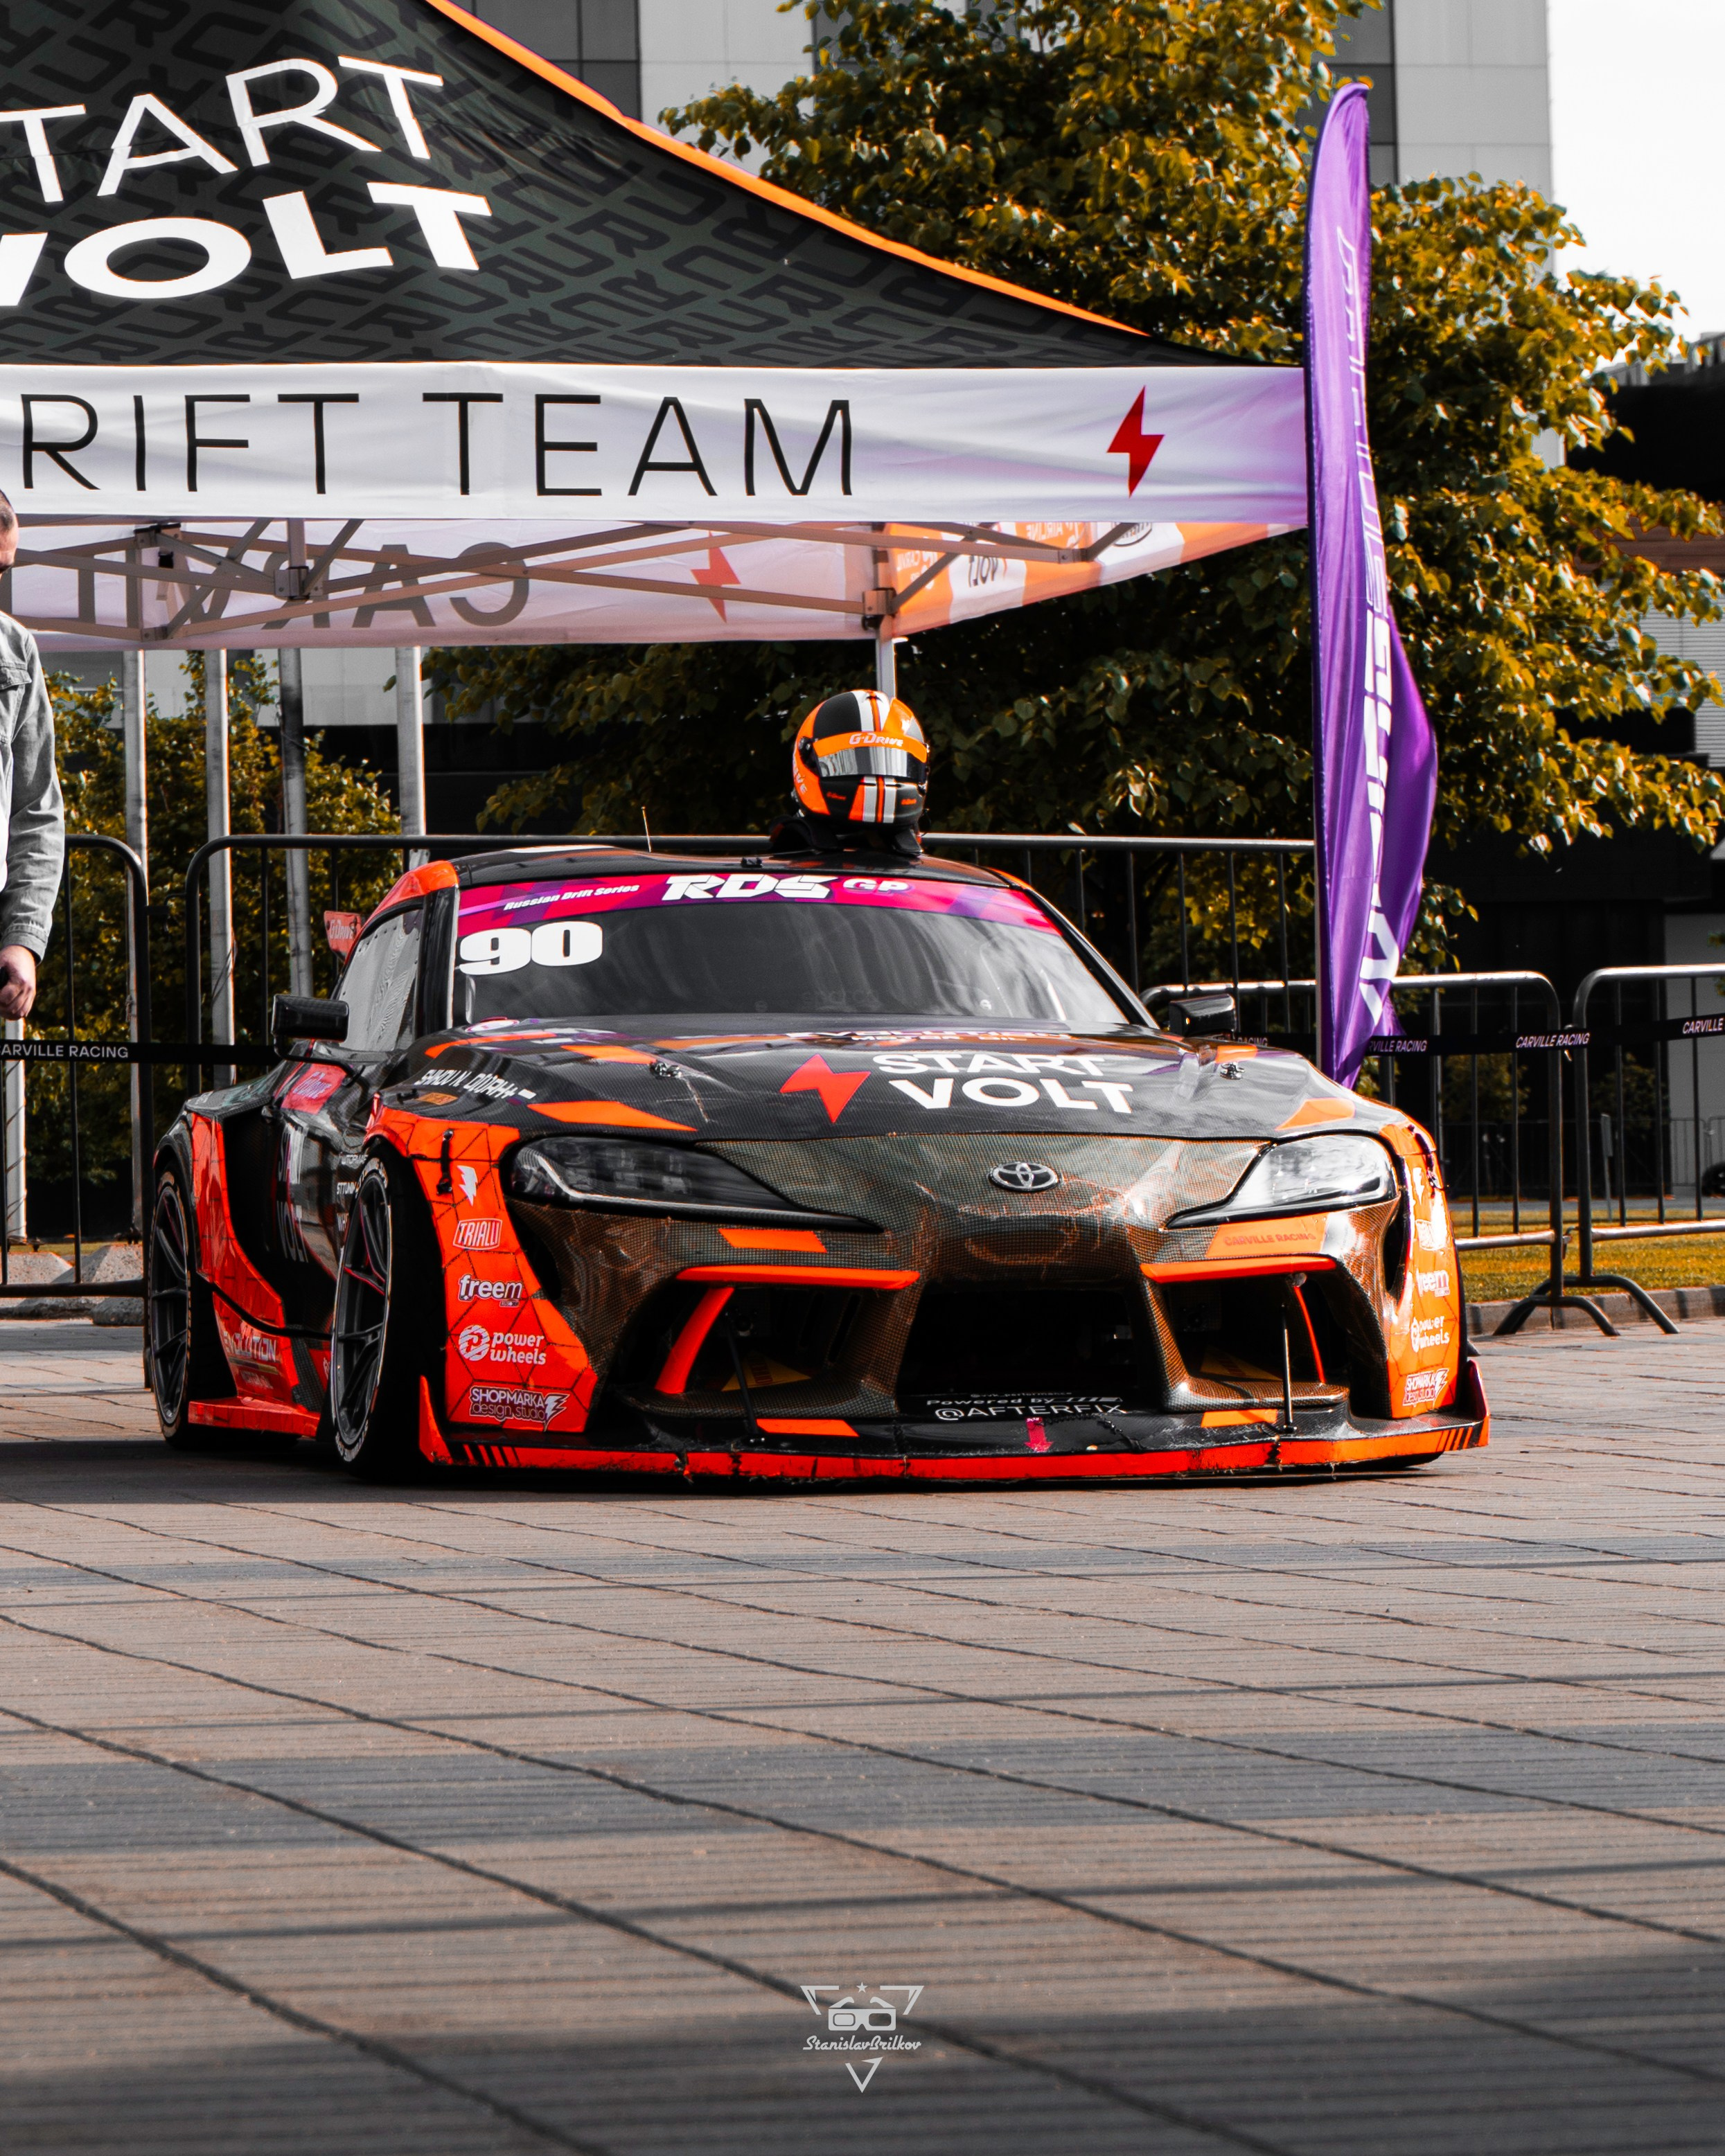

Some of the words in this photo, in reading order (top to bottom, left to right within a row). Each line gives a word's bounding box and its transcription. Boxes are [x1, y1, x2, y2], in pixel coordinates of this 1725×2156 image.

[423, 392, 852, 497] TEAM
[662, 874, 839, 901] RDS
[843, 878, 909, 894] GP
[504, 894, 560, 911] Russian
[561, 889, 592, 900] Drift
[594, 884, 640, 896] Series
[459, 920, 603, 975] 90
[1682, 1017, 1724, 1034] CARVILLE
[1395, 1040, 1428, 1052] RACING
[1516, 1035, 1557, 1048] CARVILLE
[1556, 1033, 1591, 1046] RACING
[0, 1044, 64, 1057] ARVILLE
[69, 1045, 129, 1058] RACING
[872, 1053, 1105, 1076] START
[889, 1077, 1134, 1114] VOLT
[458, 1221, 499, 1247] TRIALLI
[1223, 1235, 1275, 1247] CARVILLE
[1275, 1233, 1316, 1242] RACING
[460, 1274, 523, 1299] freem
[491, 1332, 545, 1348] power
[1419, 1328, 1450, 1348] wheels
[490, 1346, 547, 1365] wheels
[472, 1388, 545, 1409] SHOPMARKA
[935, 1405, 1128, 1420] @AFTERFIX
